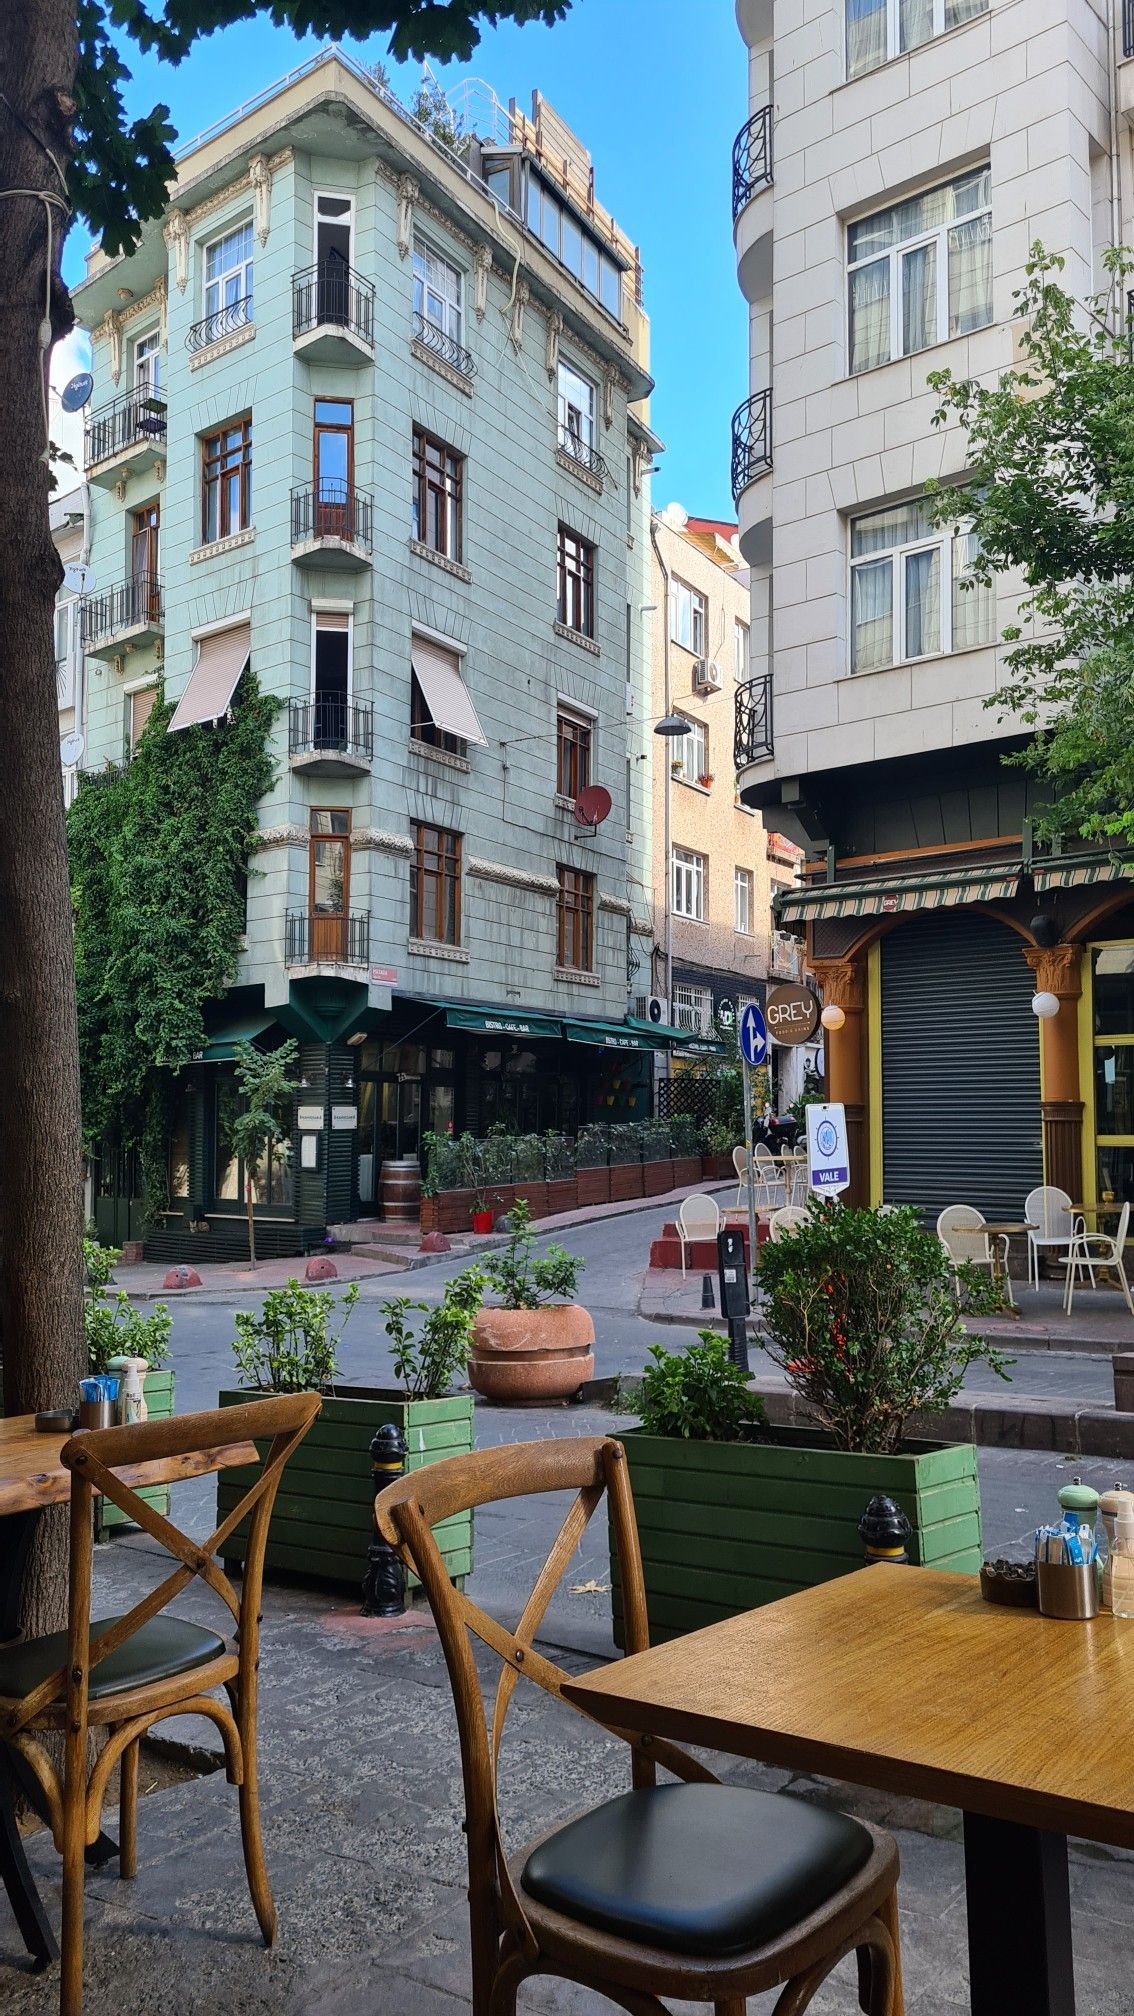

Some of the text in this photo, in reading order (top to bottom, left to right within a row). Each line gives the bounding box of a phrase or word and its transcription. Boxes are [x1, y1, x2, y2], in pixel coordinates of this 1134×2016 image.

[768, 1000, 813, 1024] GREY
[484, 1020, 502, 1030] BISTRO
[505, 1023, 518, 1031] CAFE
[519, 1024, 530, 1032] BAR
[819, 1171, 840, 1182] VALE
